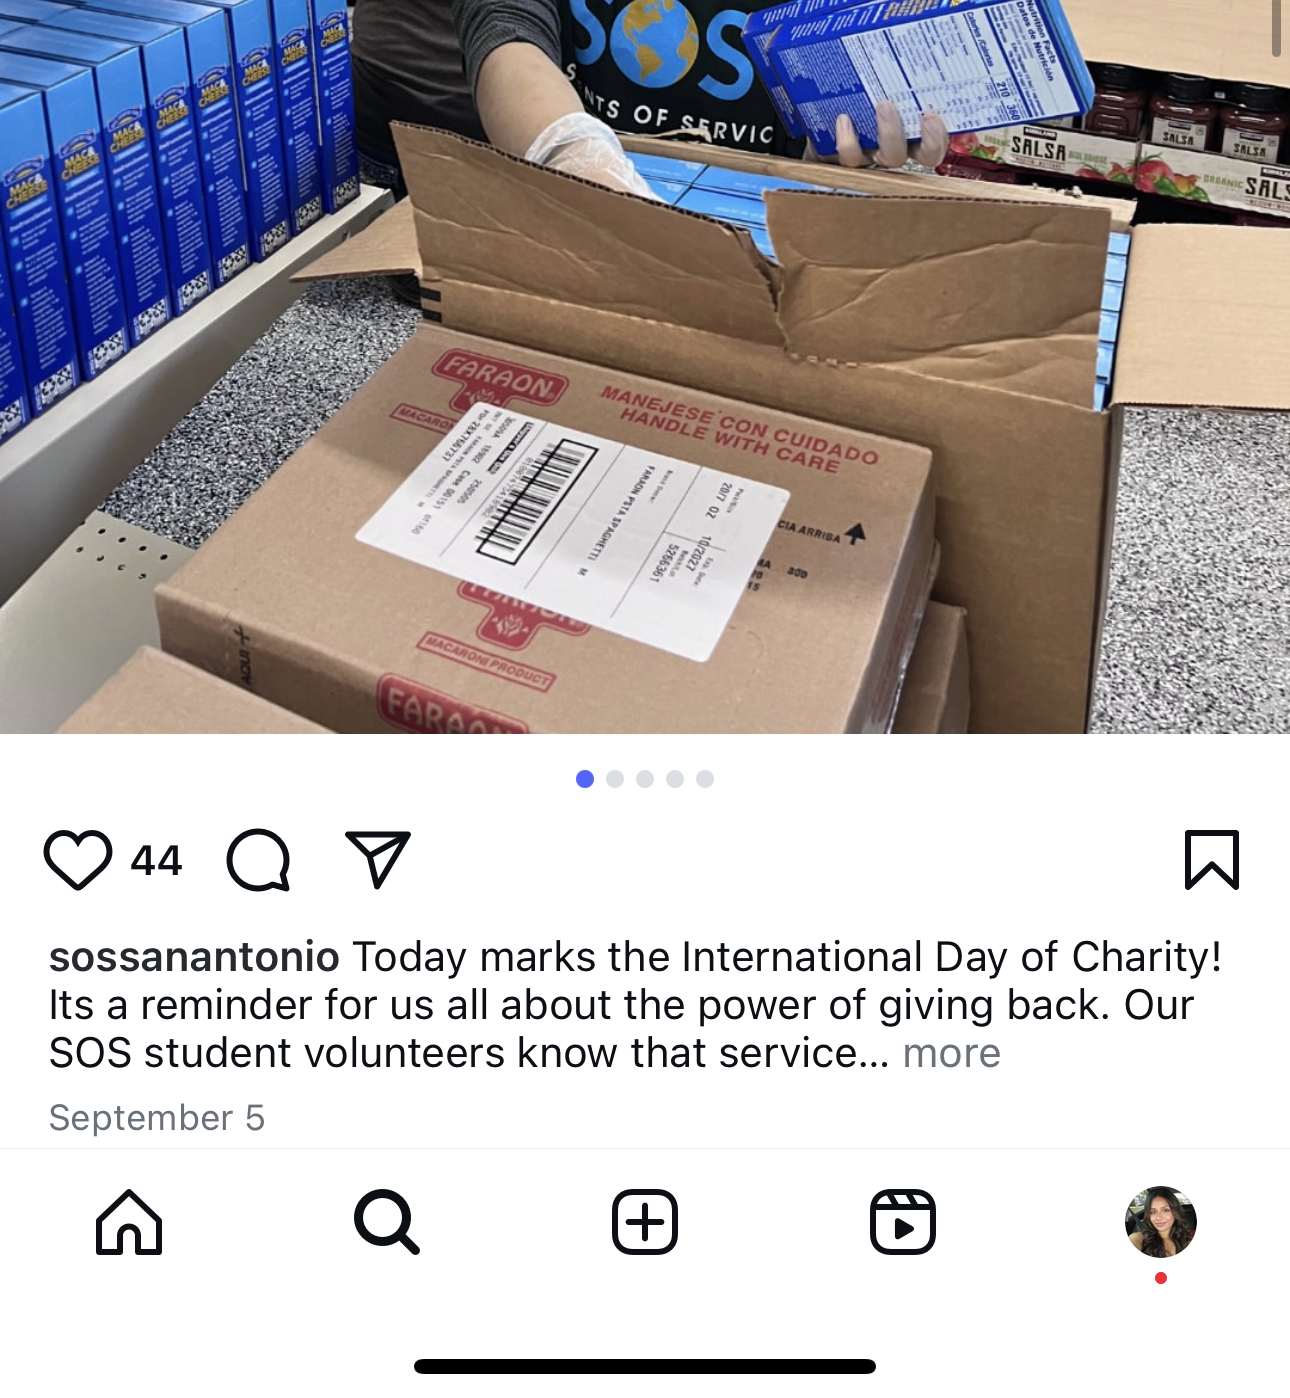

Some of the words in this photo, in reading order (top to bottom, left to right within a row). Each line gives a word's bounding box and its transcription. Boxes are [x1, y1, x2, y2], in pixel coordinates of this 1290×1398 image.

[1015, 0, 1032, 27] Datos
[1026, 27, 1037, 41] de
[1041, 39, 1058, 64] Facts
[995, 80, 1010, 98] 210
[1006, 103, 1020, 121] 360
[633, 104, 669, 127] OF
[110, 127, 146, 154] CHEESE
[1012, 135, 1066, 162] SALSA
[1163, 131, 1194, 146] SALSA
[1234, 143, 1266, 158] SALSA
[61, 153, 100, 181] CHEESE
[6, 180, 47, 210] CHEESE
[443, 355, 554, 400] FARAON
[601, 385, 715, 425] MANEJESE
[719, 415, 769, 438] CON
[773, 429, 879, 466] CUIDADO
[620, 407, 710, 441] HANDLE
[714, 431, 770, 456] WITH
[776, 446, 842, 474] CARE
[630, 465, 656, 495] FARAON
[616, 495, 636, 516] PSTA
[705, 506, 720, 519] OZ
[587, 517, 622, 561] SPAGHETTI
[798, 525, 841, 544] ARRIBA
[686, 535, 712, 572] 10/2027
[577, 568, 589, 576] M
[424, 635, 492, 668] MACARONI
[490, 659, 551, 688] PRODUCT
